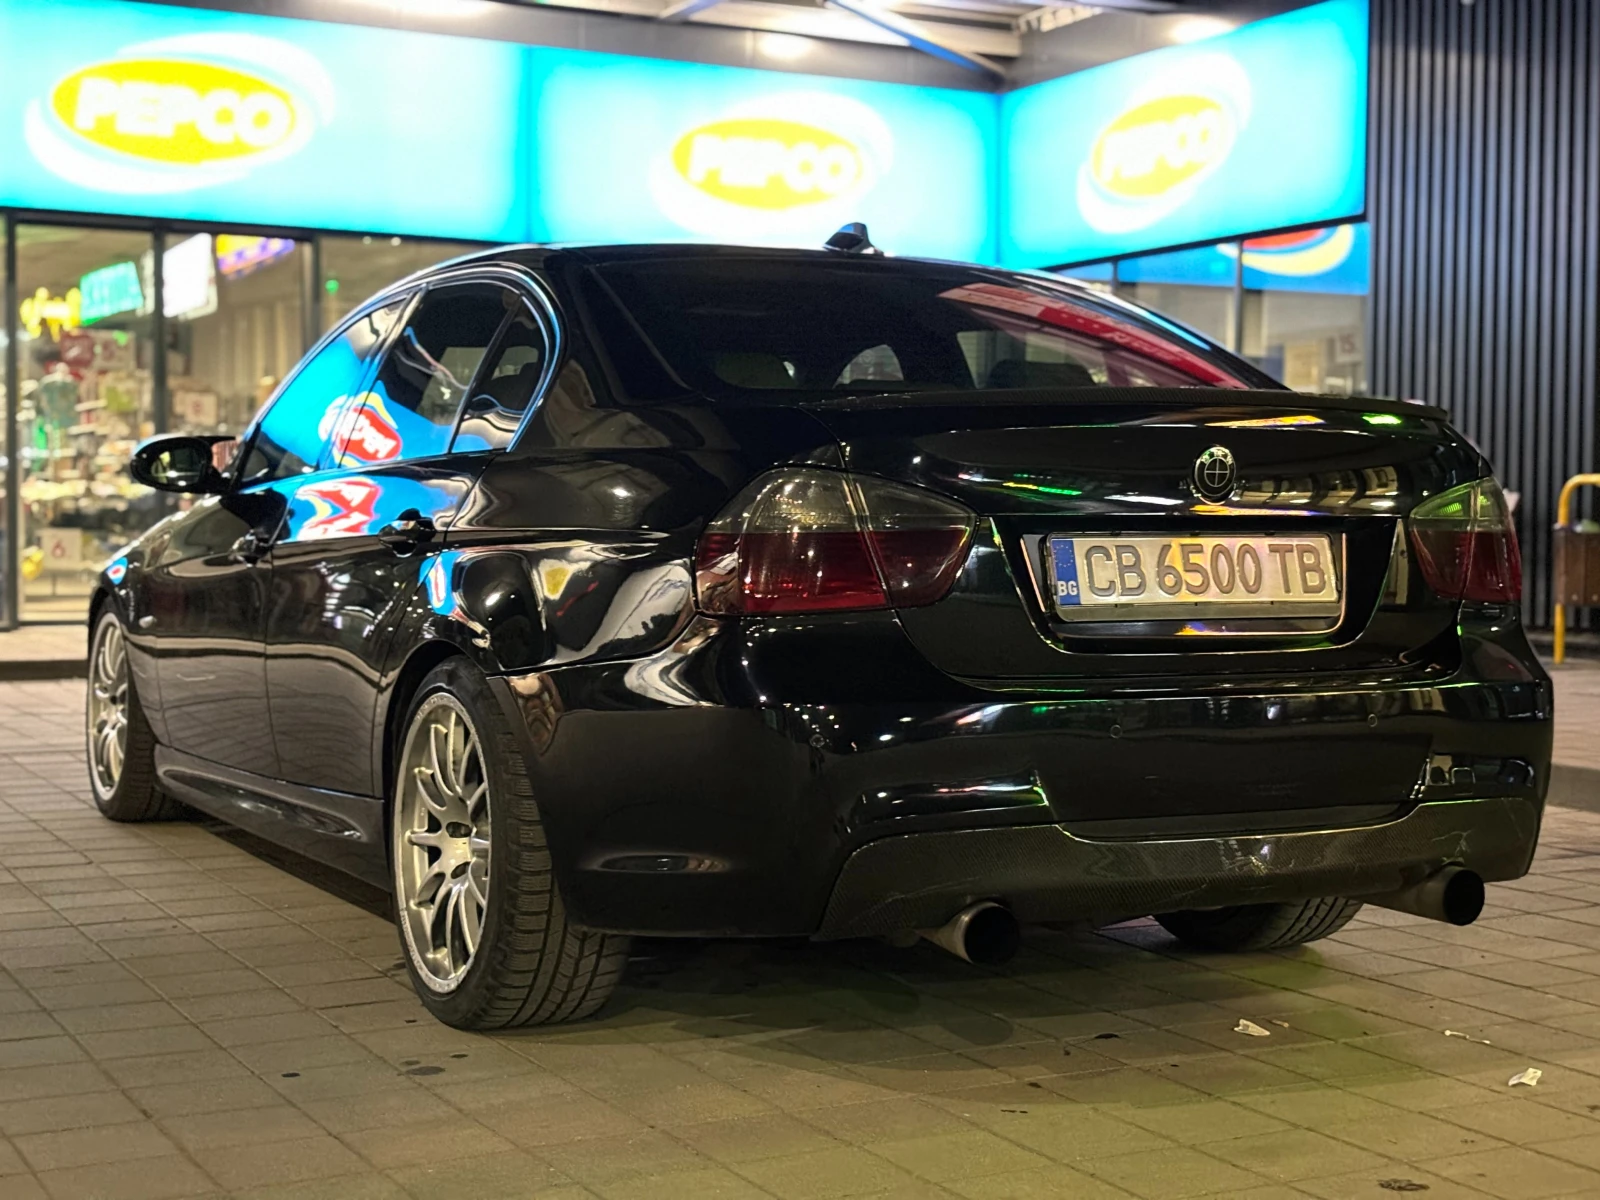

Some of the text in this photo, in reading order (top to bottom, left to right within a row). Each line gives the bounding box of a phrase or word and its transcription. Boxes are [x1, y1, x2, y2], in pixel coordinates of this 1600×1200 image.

[75, 78, 291, 147] PEPCO
[690, 135, 855, 193] PEPCO
[1057, 581, 1078, 596] BG
[1085, 543, 1326, 596] CB 6500 TB
